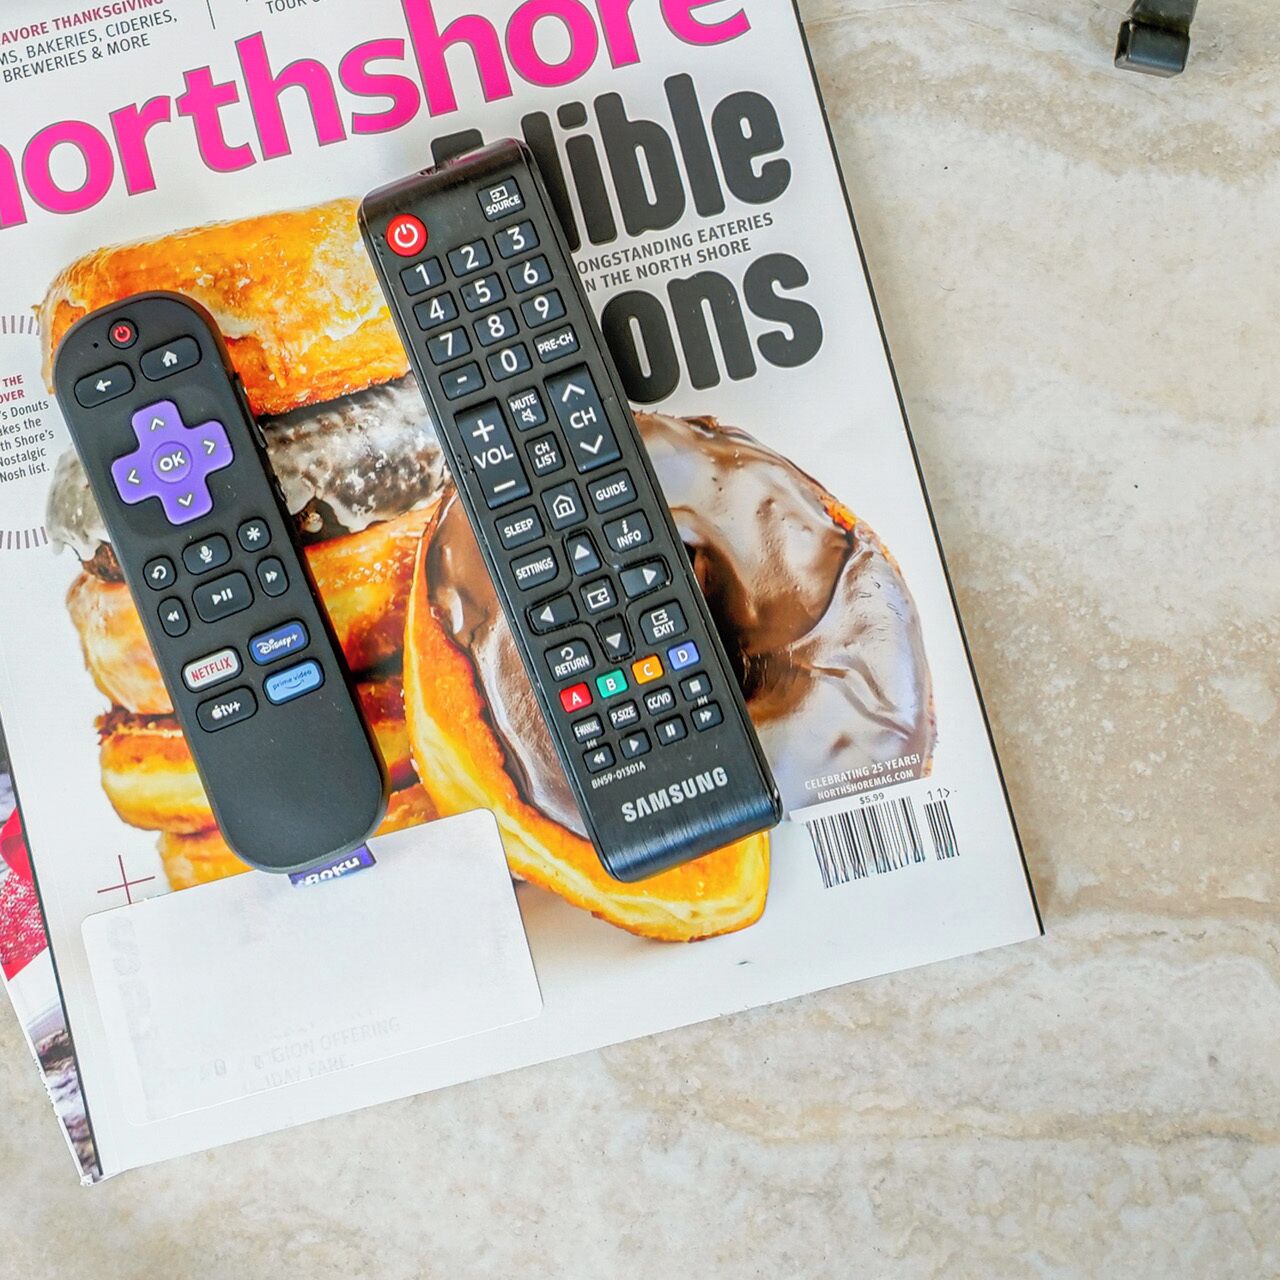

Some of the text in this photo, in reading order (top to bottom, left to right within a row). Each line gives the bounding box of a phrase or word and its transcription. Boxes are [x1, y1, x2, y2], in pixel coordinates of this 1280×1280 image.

[26, 29, 102, 58] BAKERIES,
[105, 9, 178, 37] CIDERIES,
[3, 33, 151, 83] BREWERIES & MORE
[430, 73, 792, 253] ible
[485, 194, 521, 216] SOURCE
[507, 227, 525, 250] 3
[577, 212, 773, 275] ONGSTANDING EATERIES
[461, 246, 479, 270] 2
[584, 237, 752, 293] N THE NORTH SHORE
[415, 264, 431, 286] 1
[523, 261, 539, 284] 6
[474, 280, 491, 303] 5
[429, 298, 445, 320] 4
[534, 296, 549, 319] 9
[487, 314, 505, 338] 8
[601, 252, 822, 404] ons
[439, 333, 453, 356] 7
[537, 332, 574, 354] PRE-CH
[500, 350, 518, 372] 0
[2, 374, 24, 388] THE
[10, 400, 50, 418] Donuts
[510, 394, 537, 412] MUTE
[23, 417, 42, 430] the
[570, 407, 597, 429] CH
[14, 429, 55, 448] Shore's
[535, 442, 550, 456] CH
[159, 451, 186, 471] OK
[473, 444, 514, 470] VOL
[535, 452, 557, 468] LIST
[0, 462, 50, 483] Nosh list.
[595, 481, 628, 502] GUIDE
[503, 519, 534, 538] SLEEP
[617, 530, 642, 548] INFO
[515, 557, 554, 580] SETTINGS
[652, 623, 676, 638] EXIT
[554, 655, 590, 677] RETURN
[677, 650, 689, 663] D
[191, 657, 233, 682] NETFLIX
[272, 670, 312, 691] prime video
[643, 664, 654, 676] C
[606, 678, 617, 691] B
[571, 691, 582, 705] A
[647, 692, 671, 709] CC/VD
[611, 706, 636, 723] P.SIZE
[591, 761, 646, 789] BN59-01301A
[804, 753, 921, 790] CELEBRATING 25 YEARS!
[621, 767, 729, 822] SAMSUNG
[817, 770, 914, 800] NORTHSHOREMAG.COM
[859, 792, 885, 805] $5.99
